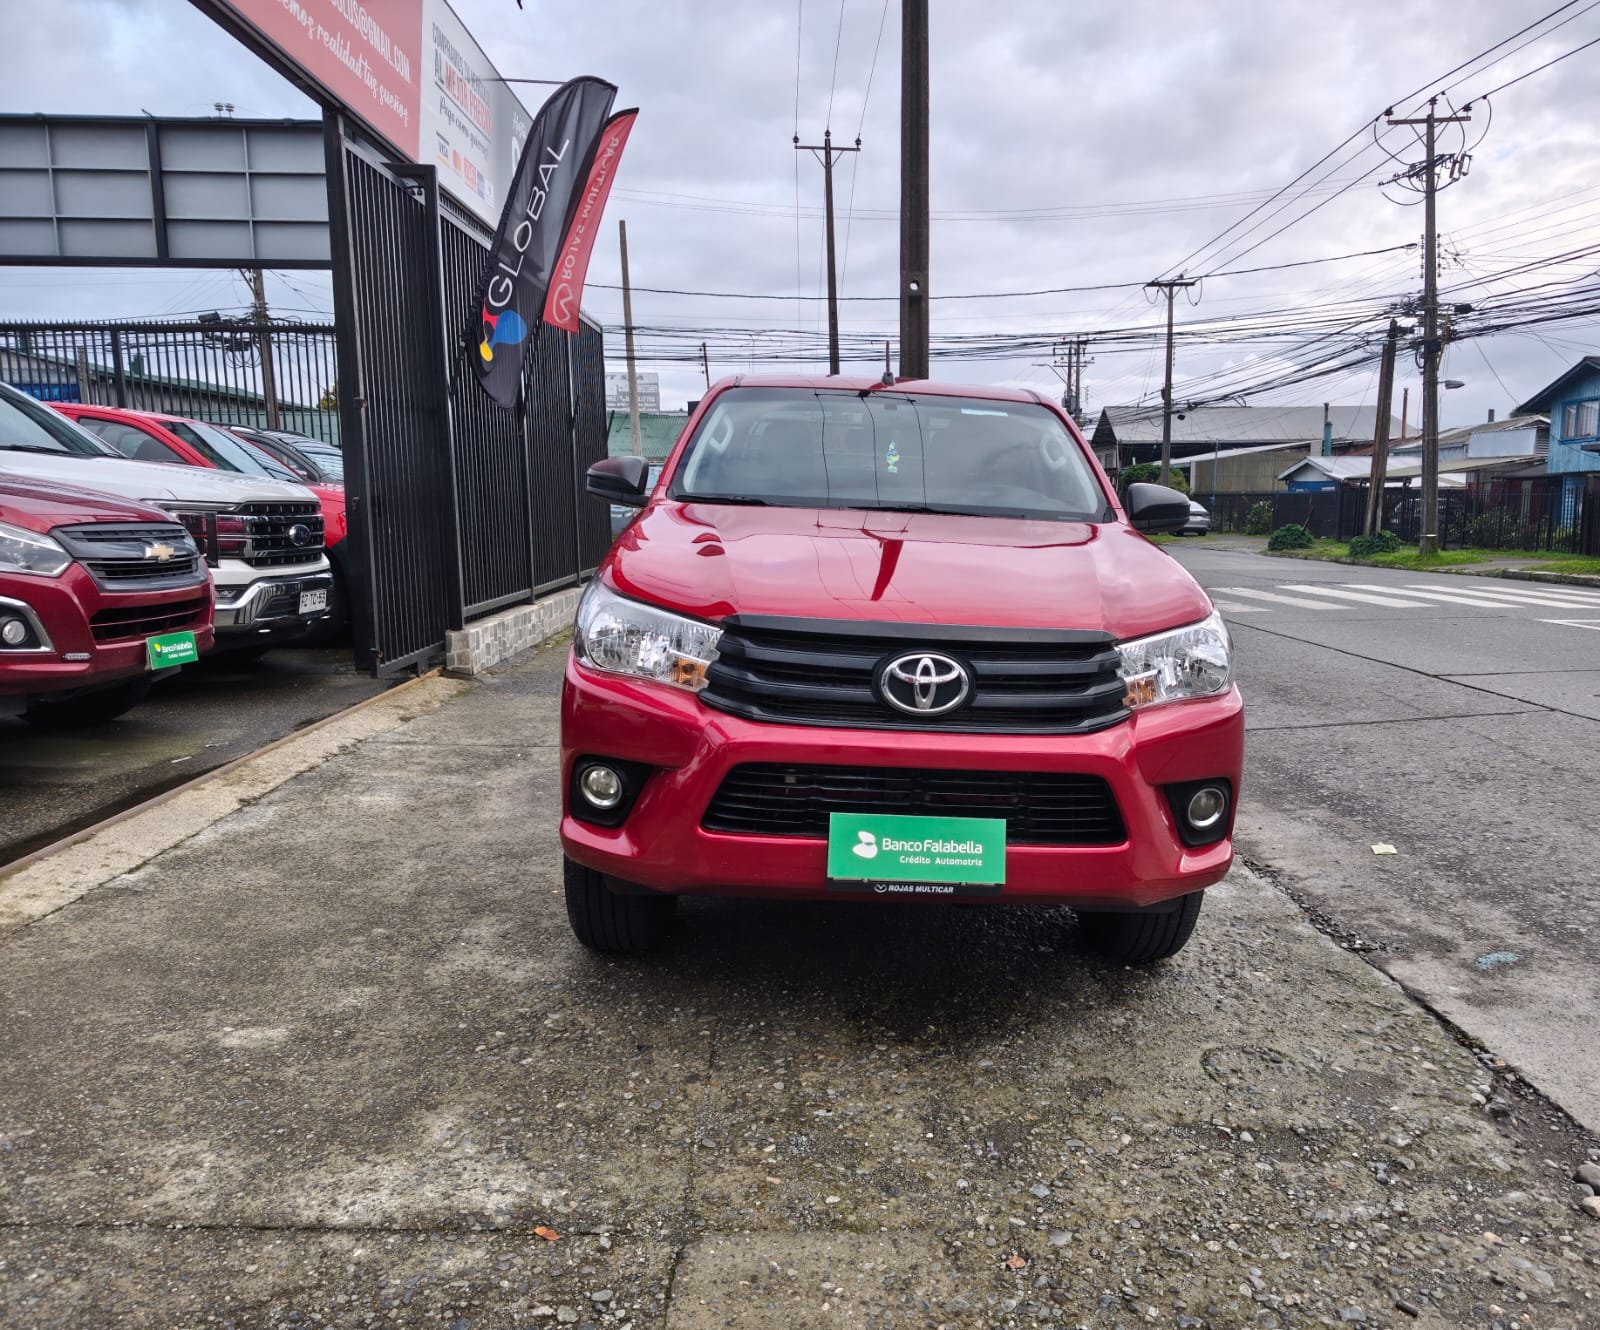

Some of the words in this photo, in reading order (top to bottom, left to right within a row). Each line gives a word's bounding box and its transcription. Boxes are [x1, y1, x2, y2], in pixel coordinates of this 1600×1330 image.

[317, 24, 362, 79] realidad
[379, 85, 409, 128] sueños
[487, 138, 570, 308] GLOBAL
[888, 884, 914, 893] ROJAS
[915, 885, 954, 894] MULTICAR
[899, 855, 931, 865] Crédito
[935, 856, 983, 866] Automotriz
